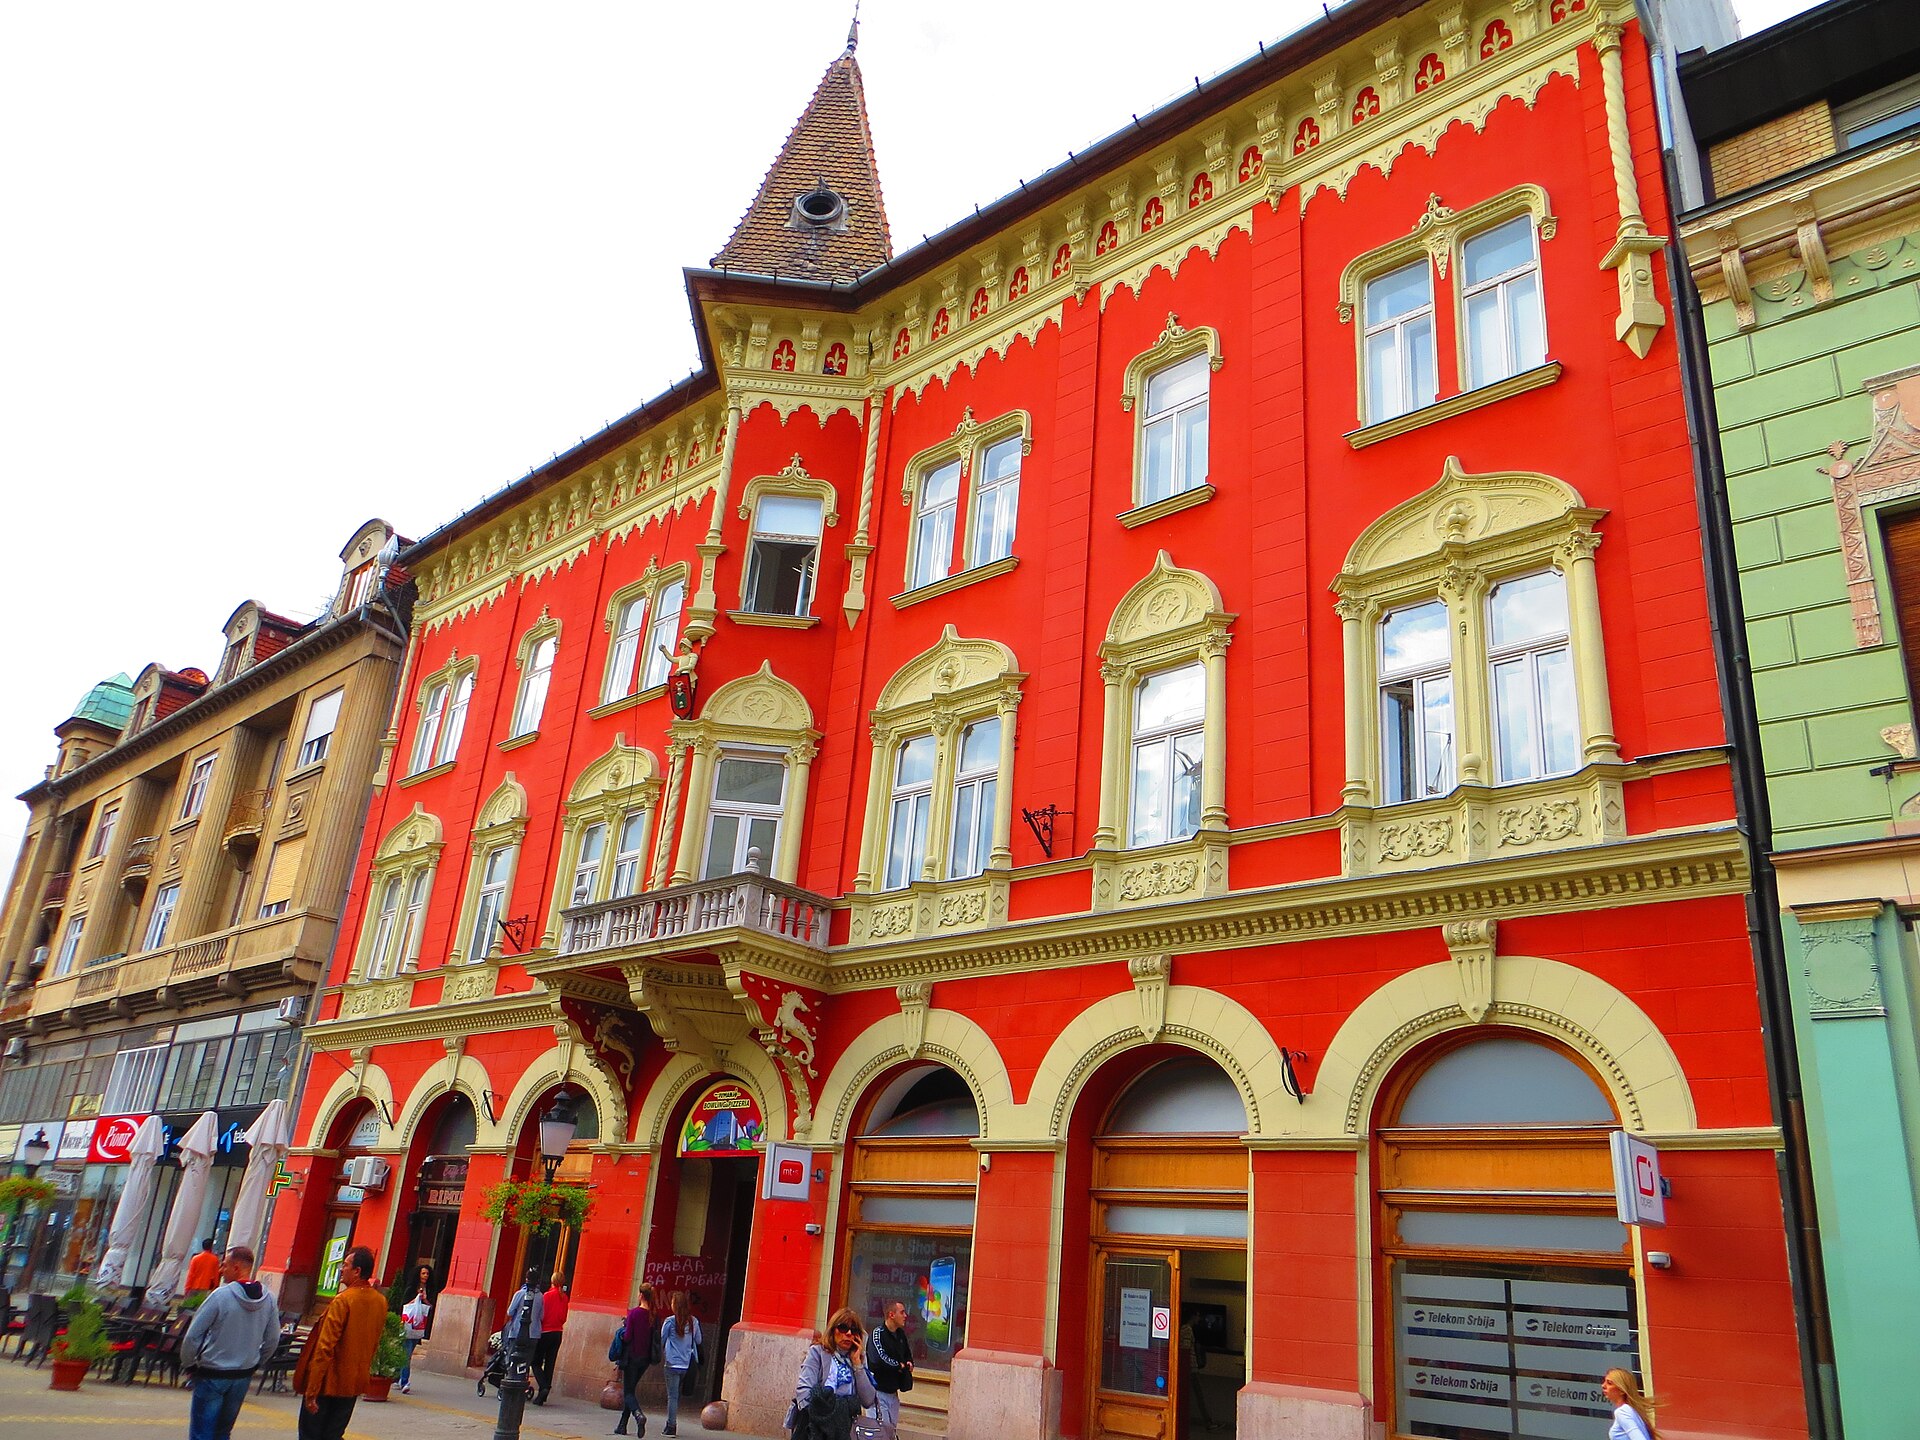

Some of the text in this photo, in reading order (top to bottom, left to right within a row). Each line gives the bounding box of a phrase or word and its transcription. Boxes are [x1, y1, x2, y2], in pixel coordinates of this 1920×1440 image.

[891, 1268, 917, 1286] Play
[1428, 1311, 1495, 1328] Telekom Srbija
[1542, 1320, 1617, 1338] Telekom Srbija
[1430, 1374, 1498, 1393] Telekom Srbija
[1546, 1385, 1587, 1400] Telekom
